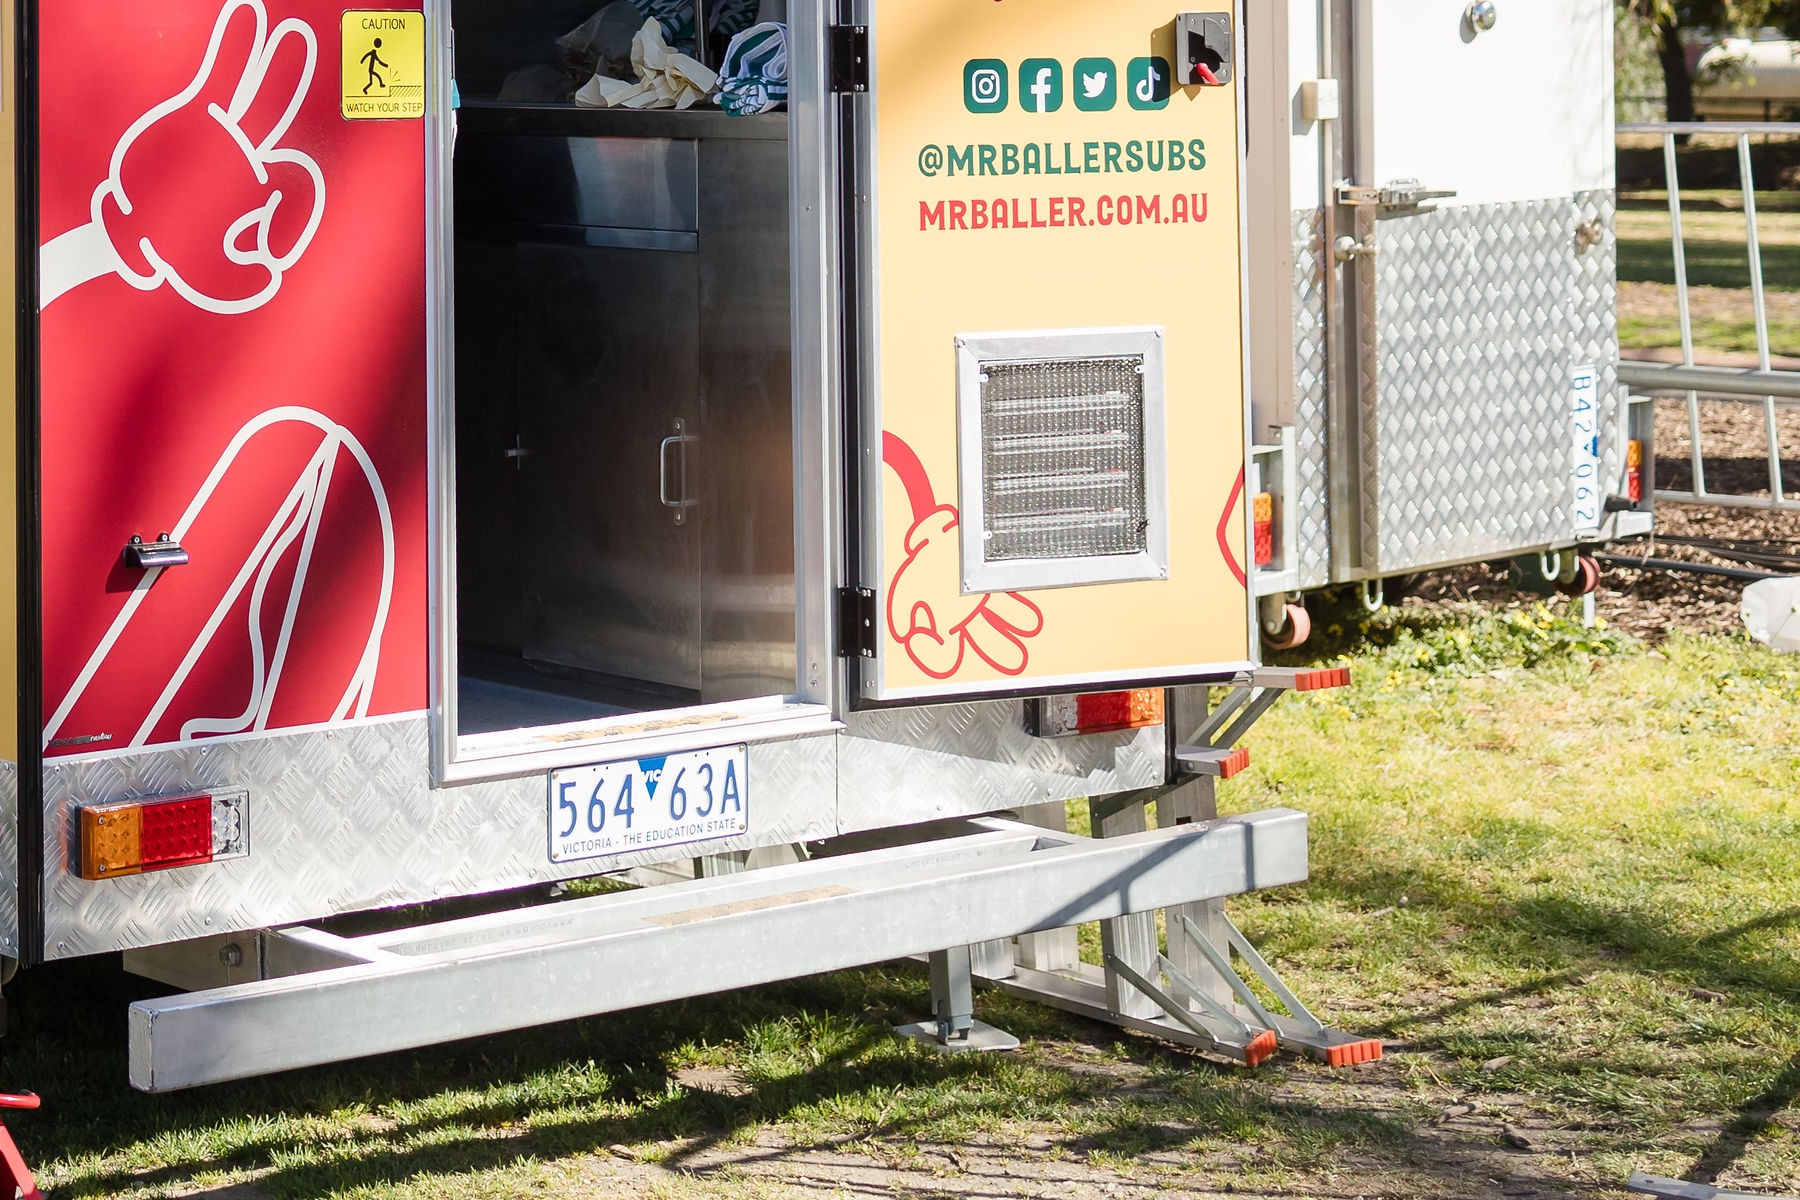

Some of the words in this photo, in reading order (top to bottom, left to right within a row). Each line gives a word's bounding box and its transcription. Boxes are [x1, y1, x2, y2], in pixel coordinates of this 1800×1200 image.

[361, 18, 406, 30] CAUTION
[346, 103, 374, 113] WATCH
[377, 103, 399, 112] YOUR
[402, 102, 422, 112] STEP
[918, 138, 1206, 177] @MRBALLERSUBS
[918, 192, 1208, 231] MRBALLER.COM.AU
[559, 773, 635, 838] 564
[670, 759, 741, 821] 63A
[563, 839, 611, 854] VICTORIA
[624, 833, 642, 846] THE
[646, 824, 703, 842] EDUCATION
[707, 818, 736, 831] STATE
